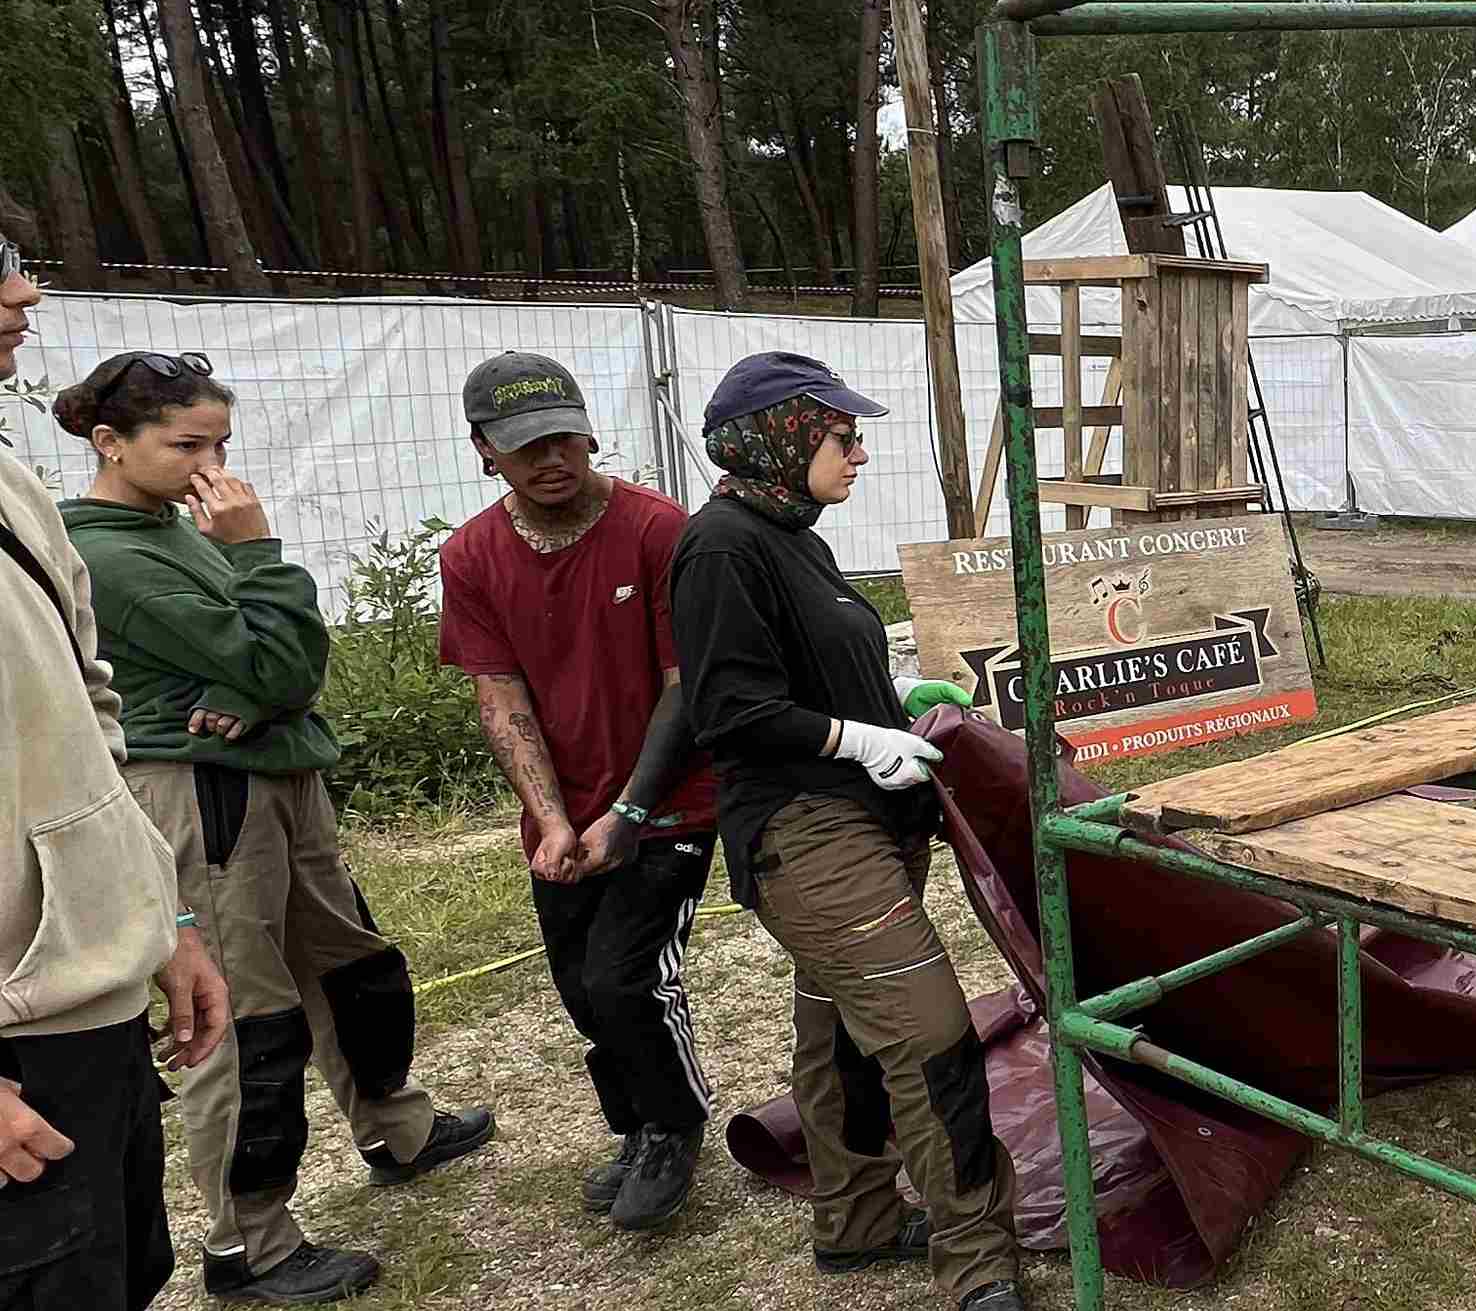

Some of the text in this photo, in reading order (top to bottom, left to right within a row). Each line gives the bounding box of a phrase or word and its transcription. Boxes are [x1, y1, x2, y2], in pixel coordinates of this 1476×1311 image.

[952, 528, 1247, 574] RESURANT CONCERT
[1107, 594, 1144, 645] C
[1007, 637, 1245, 702] CARLIE'S CAFÉ
[1123, 723, 1202, 752] PRODUITS
[1206, 704, 1292, 734] RÉGIONAUX
